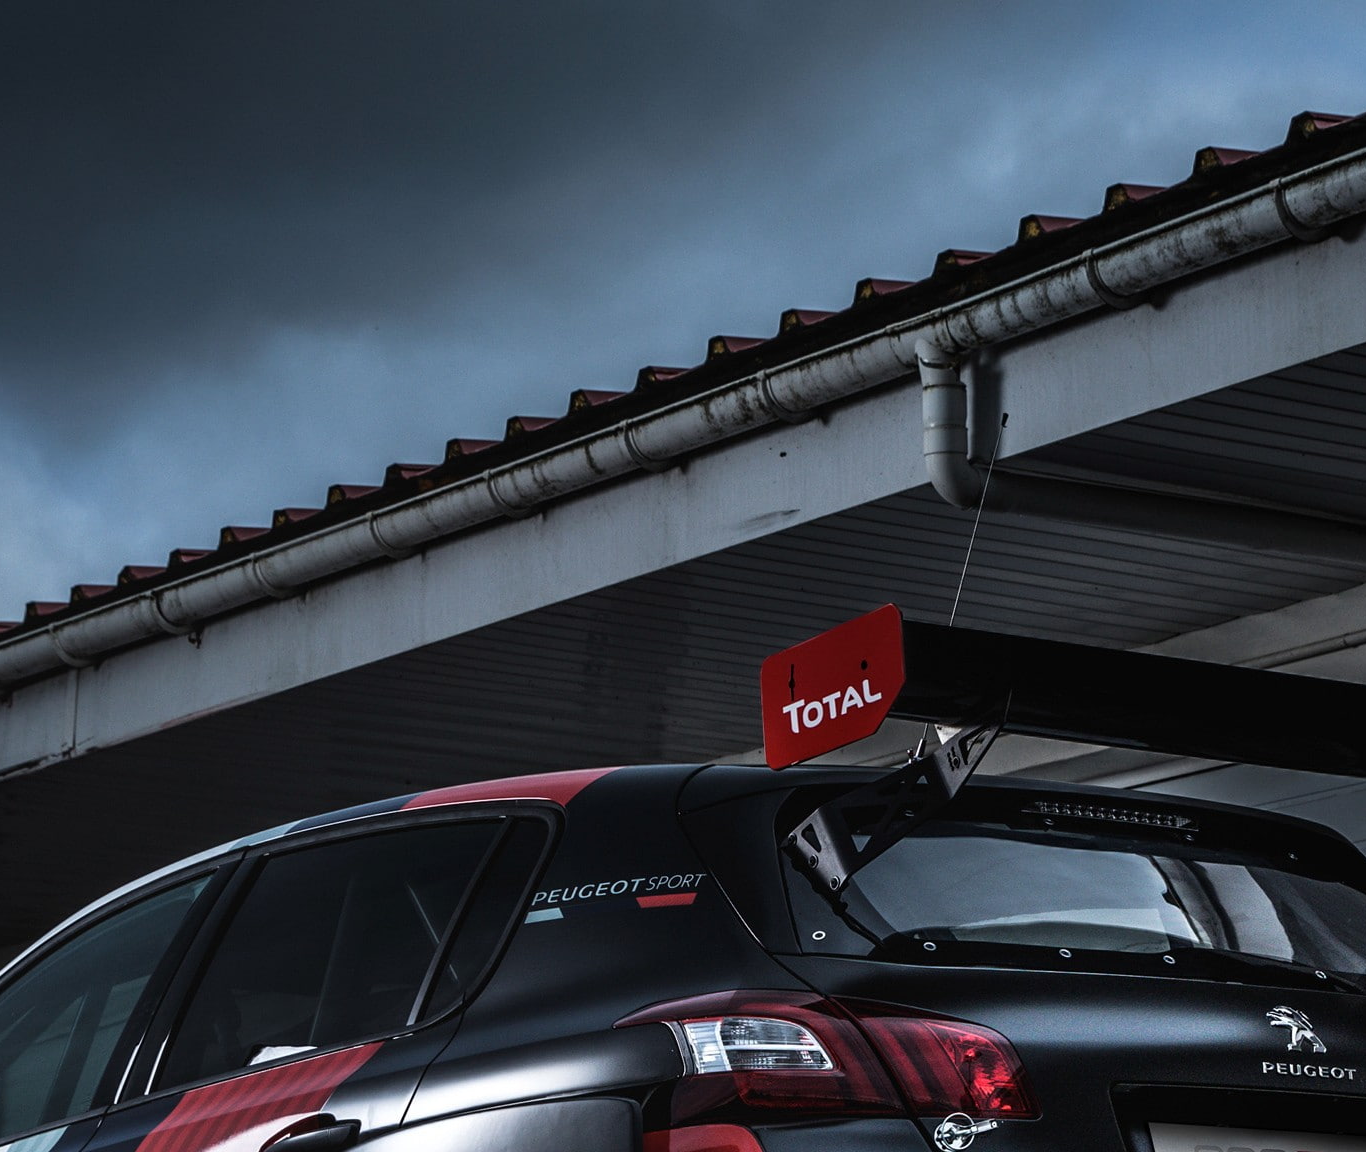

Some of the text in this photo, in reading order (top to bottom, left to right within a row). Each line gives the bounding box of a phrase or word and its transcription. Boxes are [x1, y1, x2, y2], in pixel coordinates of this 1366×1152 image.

[782, 679, 882, 734] TOTAL
[531, 873, 707, 906] PEUGEOT SPORT
[1262, 1061, 1357, 1080] PEUGEOT
